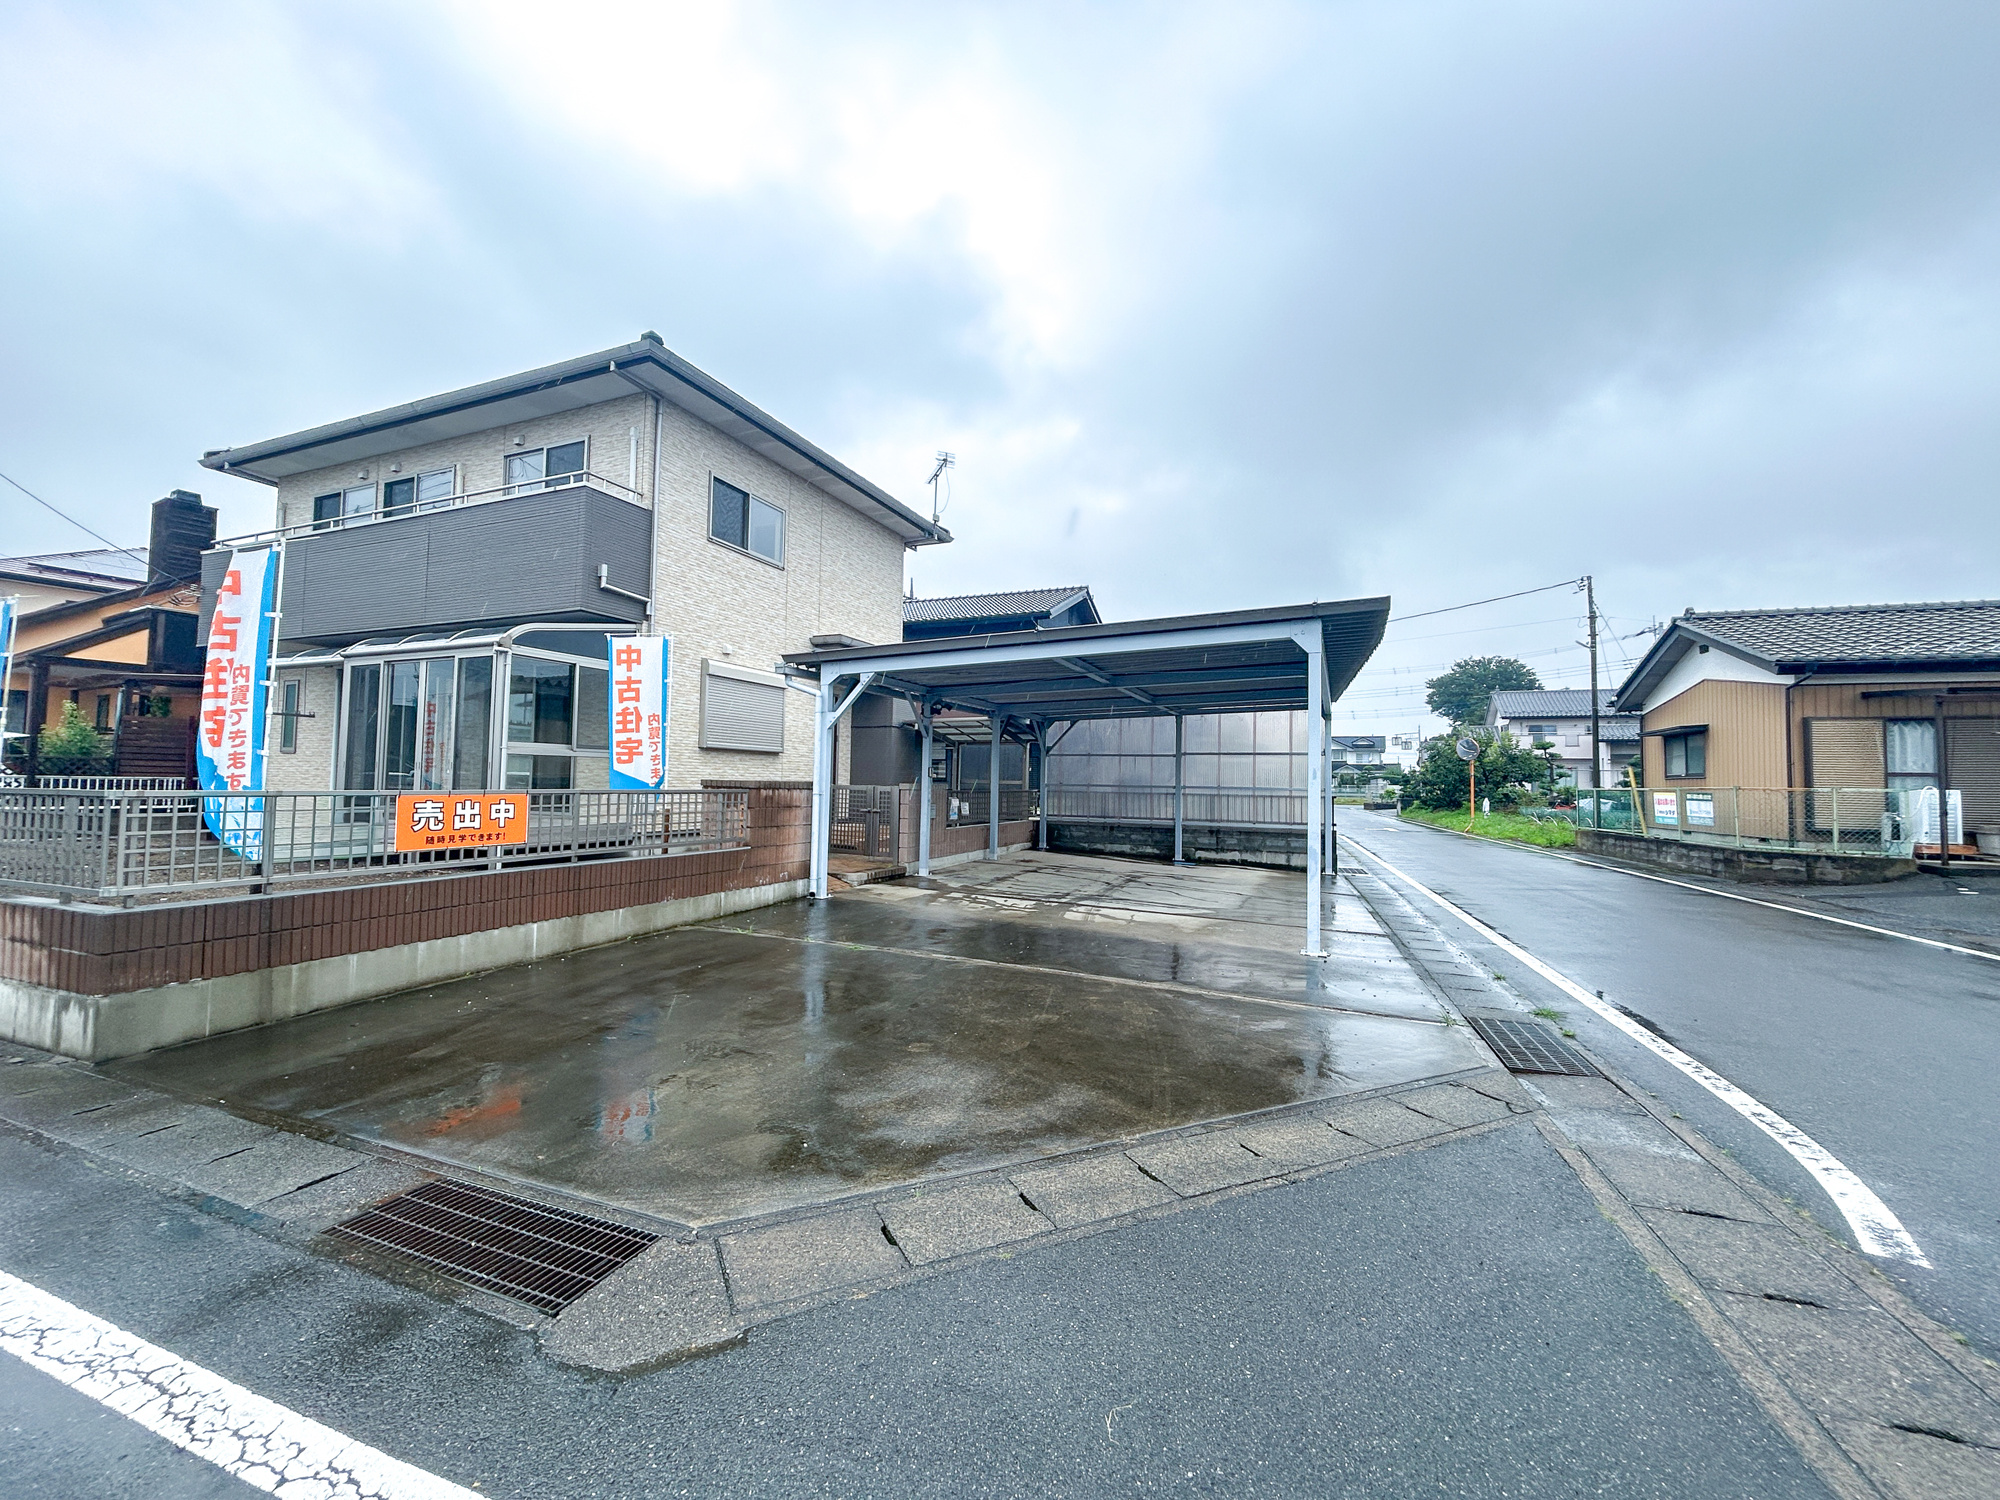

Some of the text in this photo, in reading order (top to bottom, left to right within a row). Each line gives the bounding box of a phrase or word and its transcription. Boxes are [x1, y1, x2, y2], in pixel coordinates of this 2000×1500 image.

[411, 798, 516, 832] 売出中
[425, 832, 506, 845] 随時見学できます!
